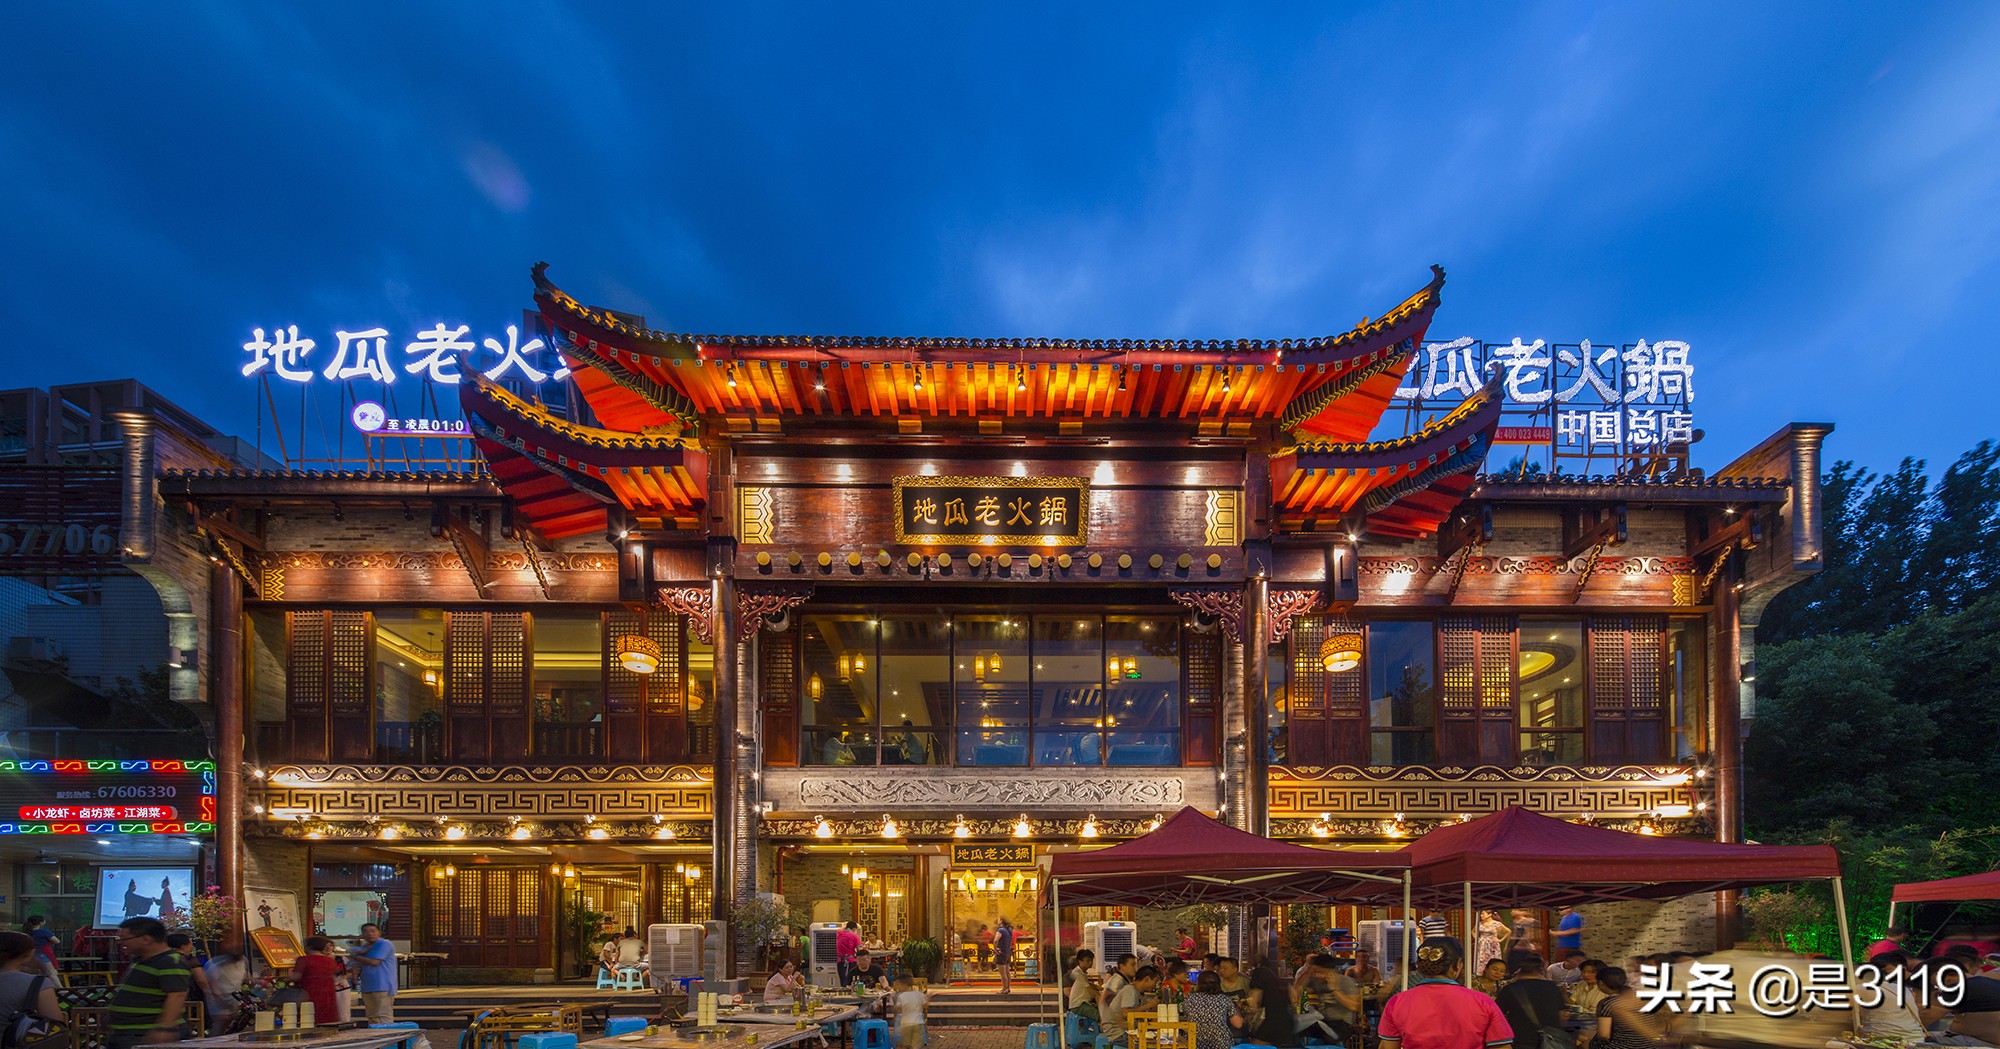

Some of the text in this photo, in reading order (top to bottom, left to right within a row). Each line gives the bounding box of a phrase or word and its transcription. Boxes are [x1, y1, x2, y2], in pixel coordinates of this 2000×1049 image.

[242, 323, 571, 384] 地瓜老火
[387, 419, 400, 430] 至
[1557, 409, 1693, 447] 中国总店
[913, 495, 1068, 526] 地瓜老火鍋
[98, 786, 177, 798] 67606330
[956, 847, 1030, 861] 地瓜老火鍋
